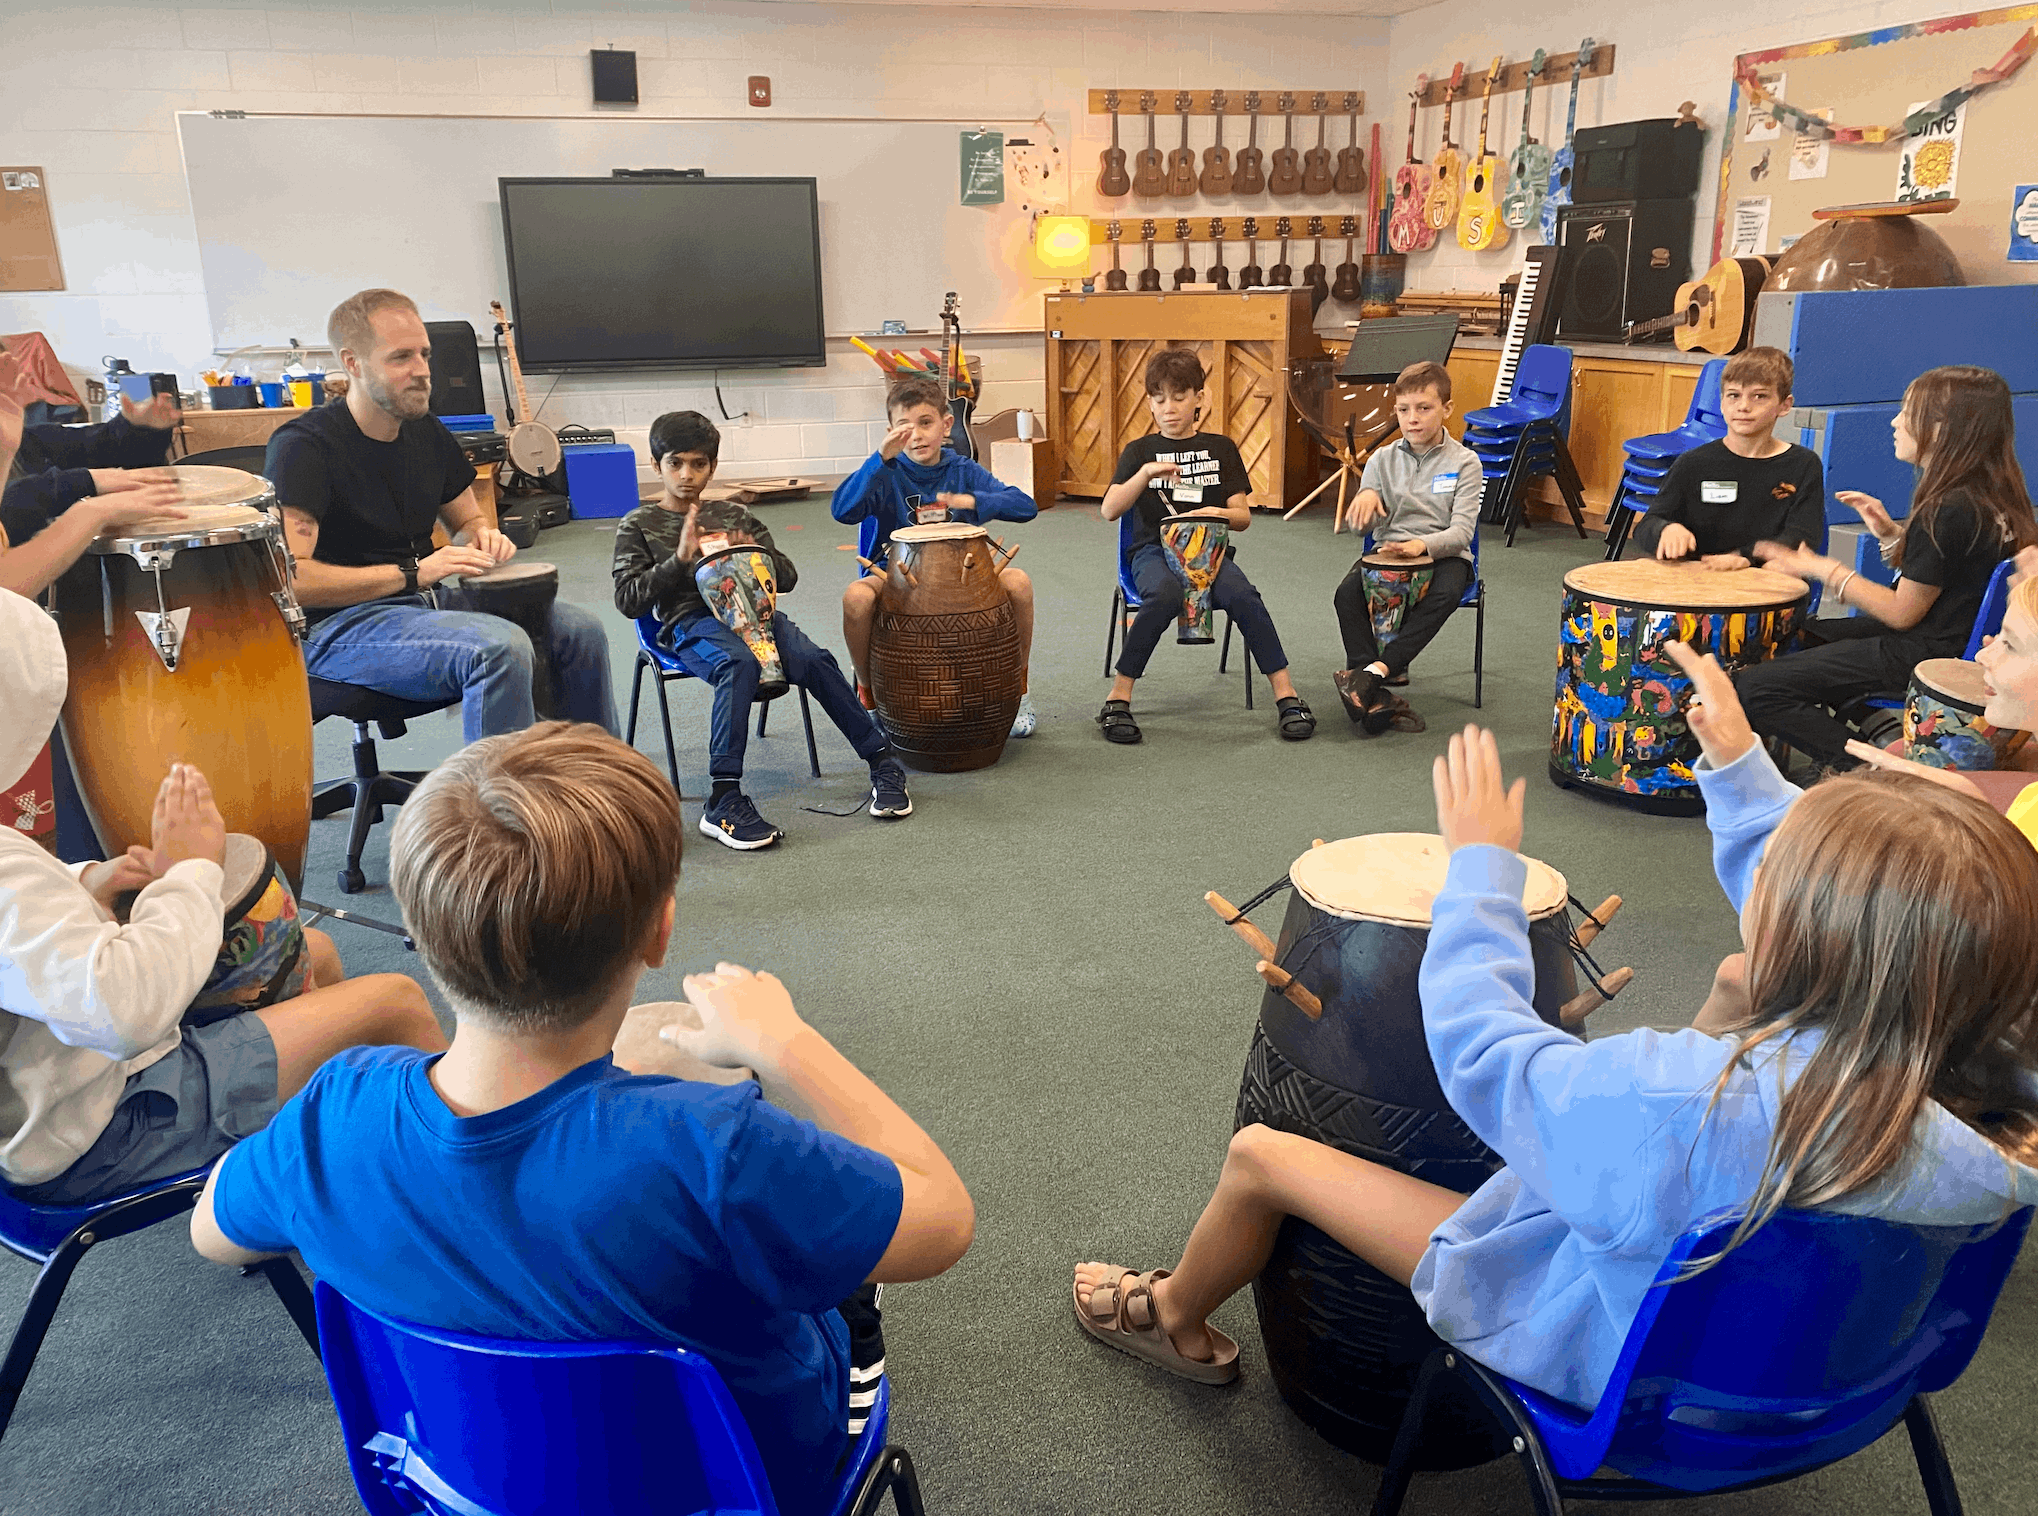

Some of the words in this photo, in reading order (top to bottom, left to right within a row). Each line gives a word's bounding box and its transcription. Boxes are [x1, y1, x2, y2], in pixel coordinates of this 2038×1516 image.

[1397, 222, 1410, 248] M
[1433, 207, 1444, 227] U
[1467, 216, 1482, 245] S
[1510, 201, 1525, 225] I
[1155, 452, 1175, 463] WHEN
[1180, 450, 1195, 463] LEFT
